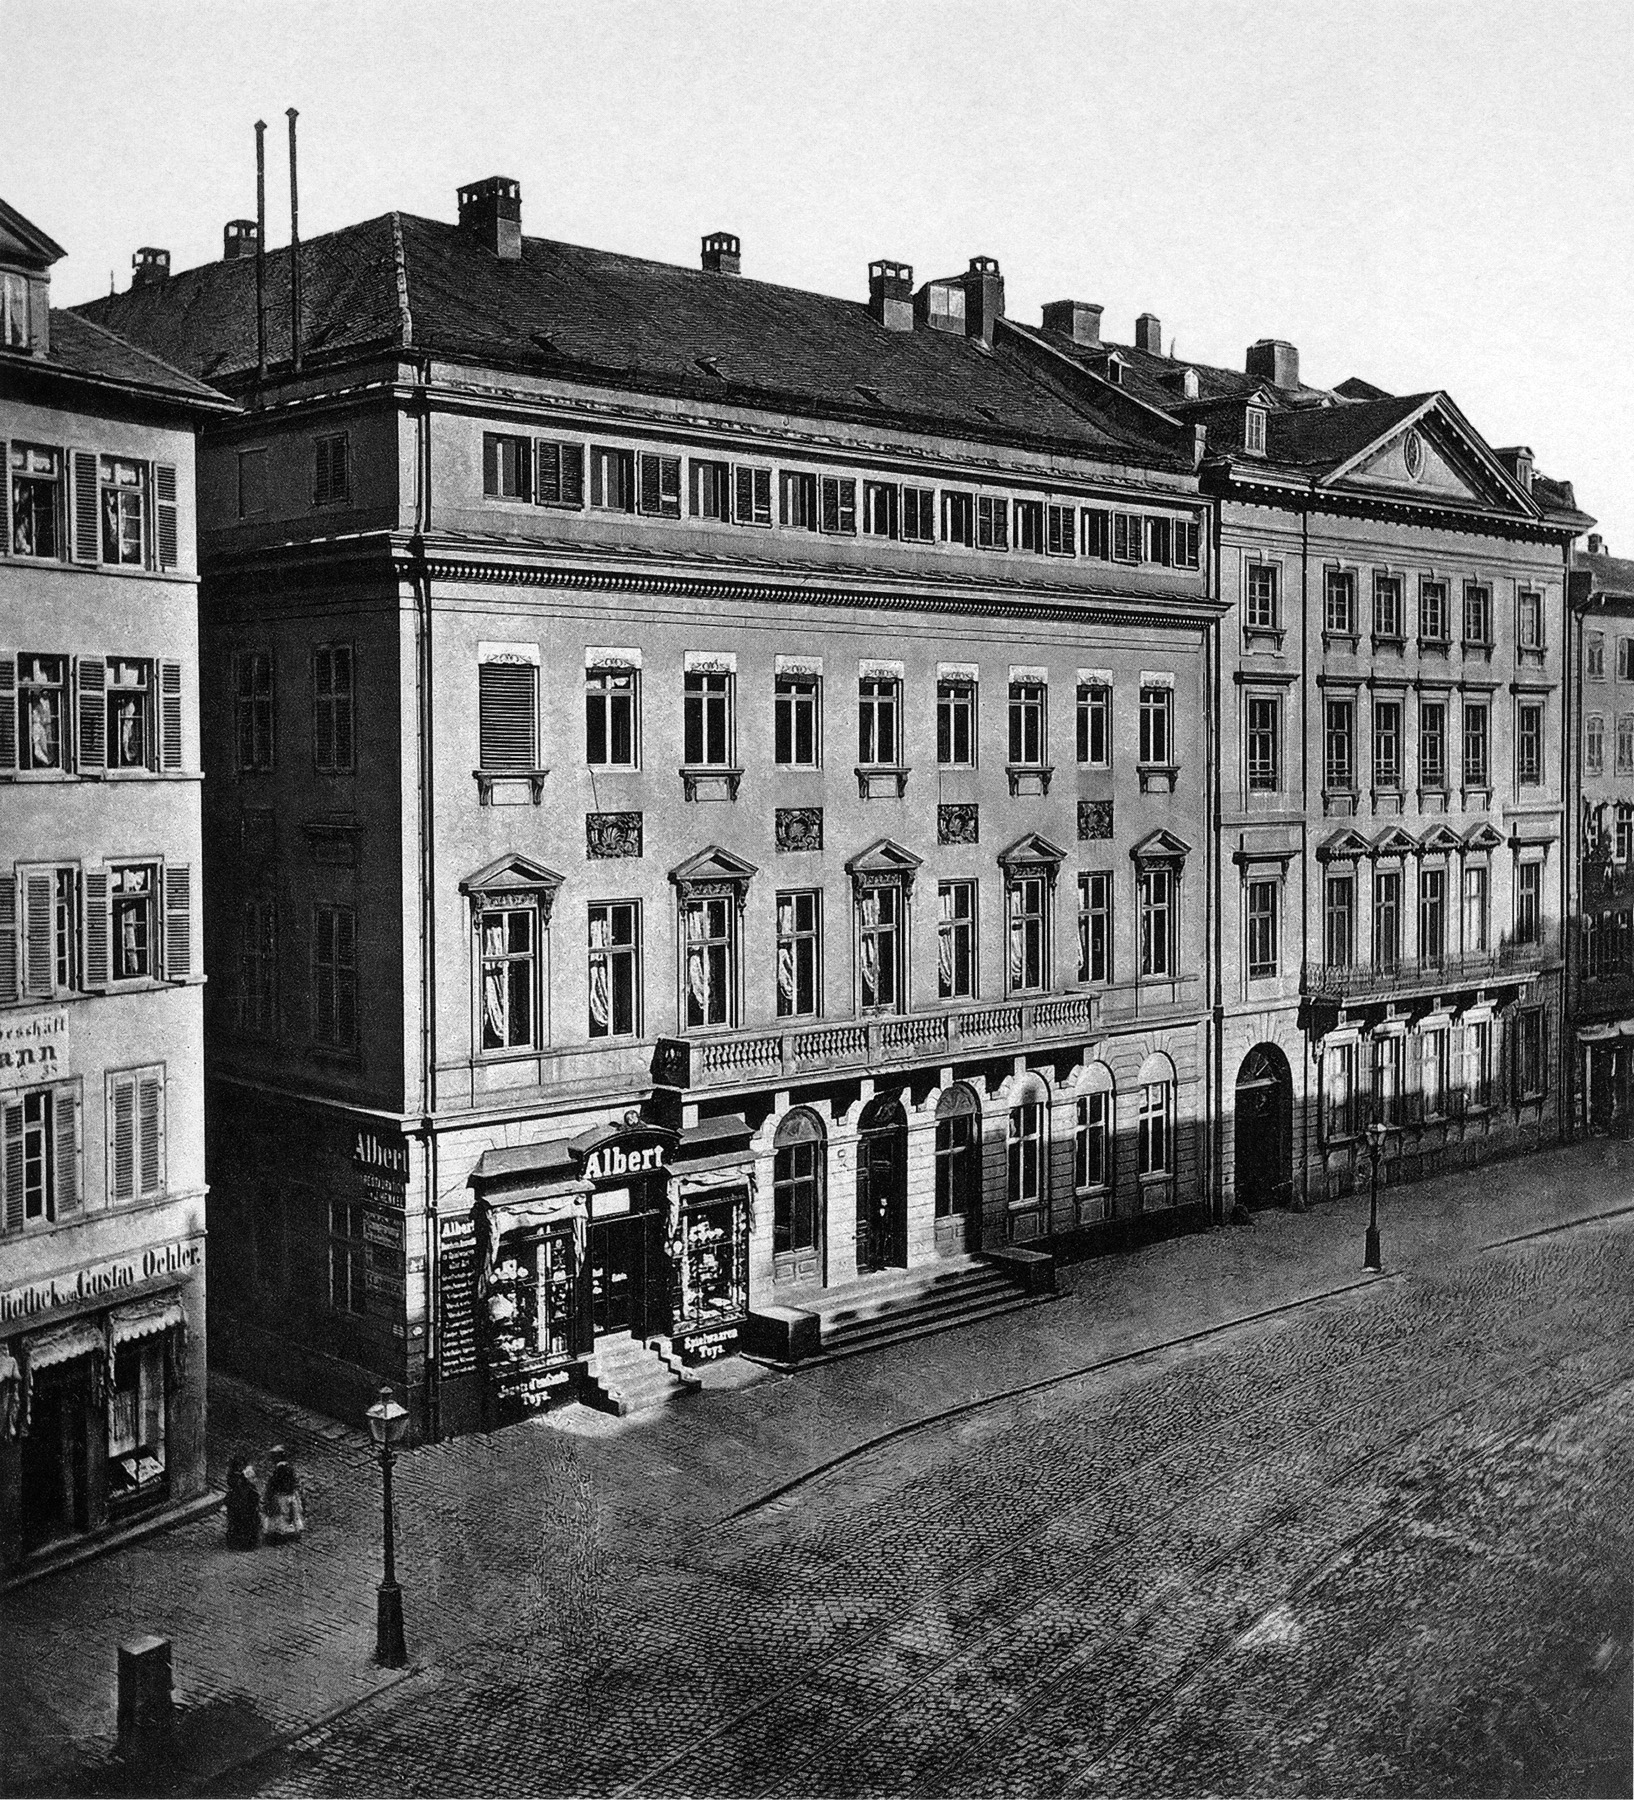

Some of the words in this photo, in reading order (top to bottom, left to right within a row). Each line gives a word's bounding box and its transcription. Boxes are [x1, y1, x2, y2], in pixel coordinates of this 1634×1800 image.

[353, 1132, 407, 1172] Albert
[584, 1145, 664, 1178] Albert
[441, 1219, 475, 1238] Albert
[77, 1265, 134, 1298] Gustav
